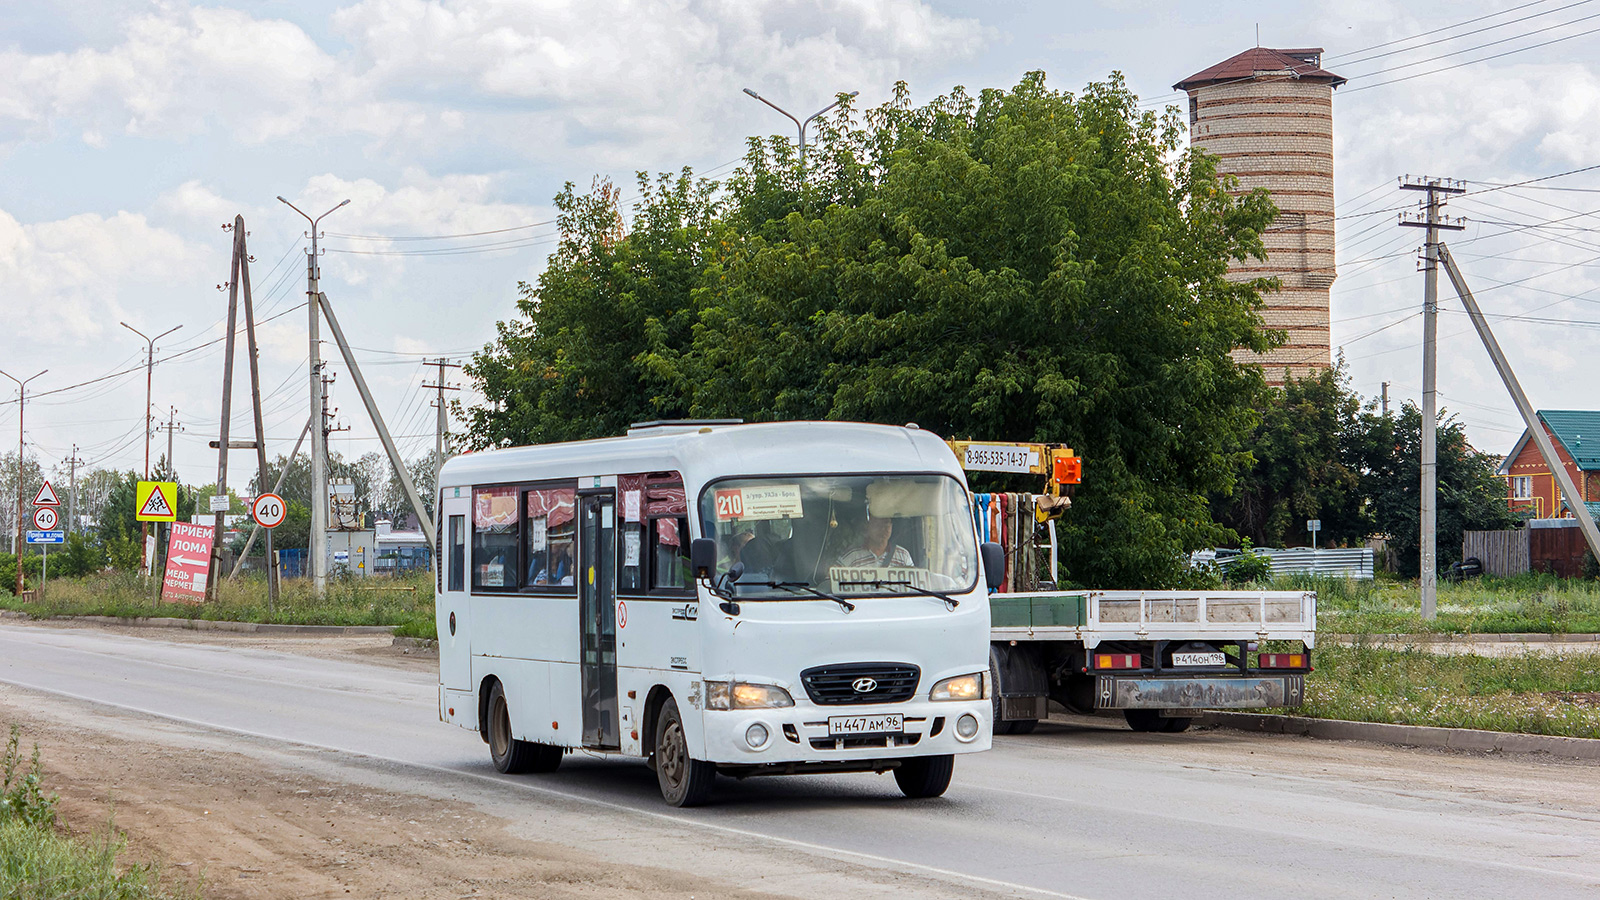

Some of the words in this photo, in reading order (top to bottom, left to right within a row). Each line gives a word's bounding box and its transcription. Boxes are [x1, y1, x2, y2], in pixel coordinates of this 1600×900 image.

[967, 450, 1028, 467] 8-965-535-14-37
[259, 503, 279, 518] 40
[718, 494, 742, 515] 210
[38, 513, 53, 524] 40
[172, 523, 213, 539] ПРИЕМ
[172, 539, 207, 554] ЛОМА
[166, 568, 190, 580] МЕДЬ
[165, 578, 193, 590] ЧЕРМЕТ
[885, 716, 898, 727] 96
